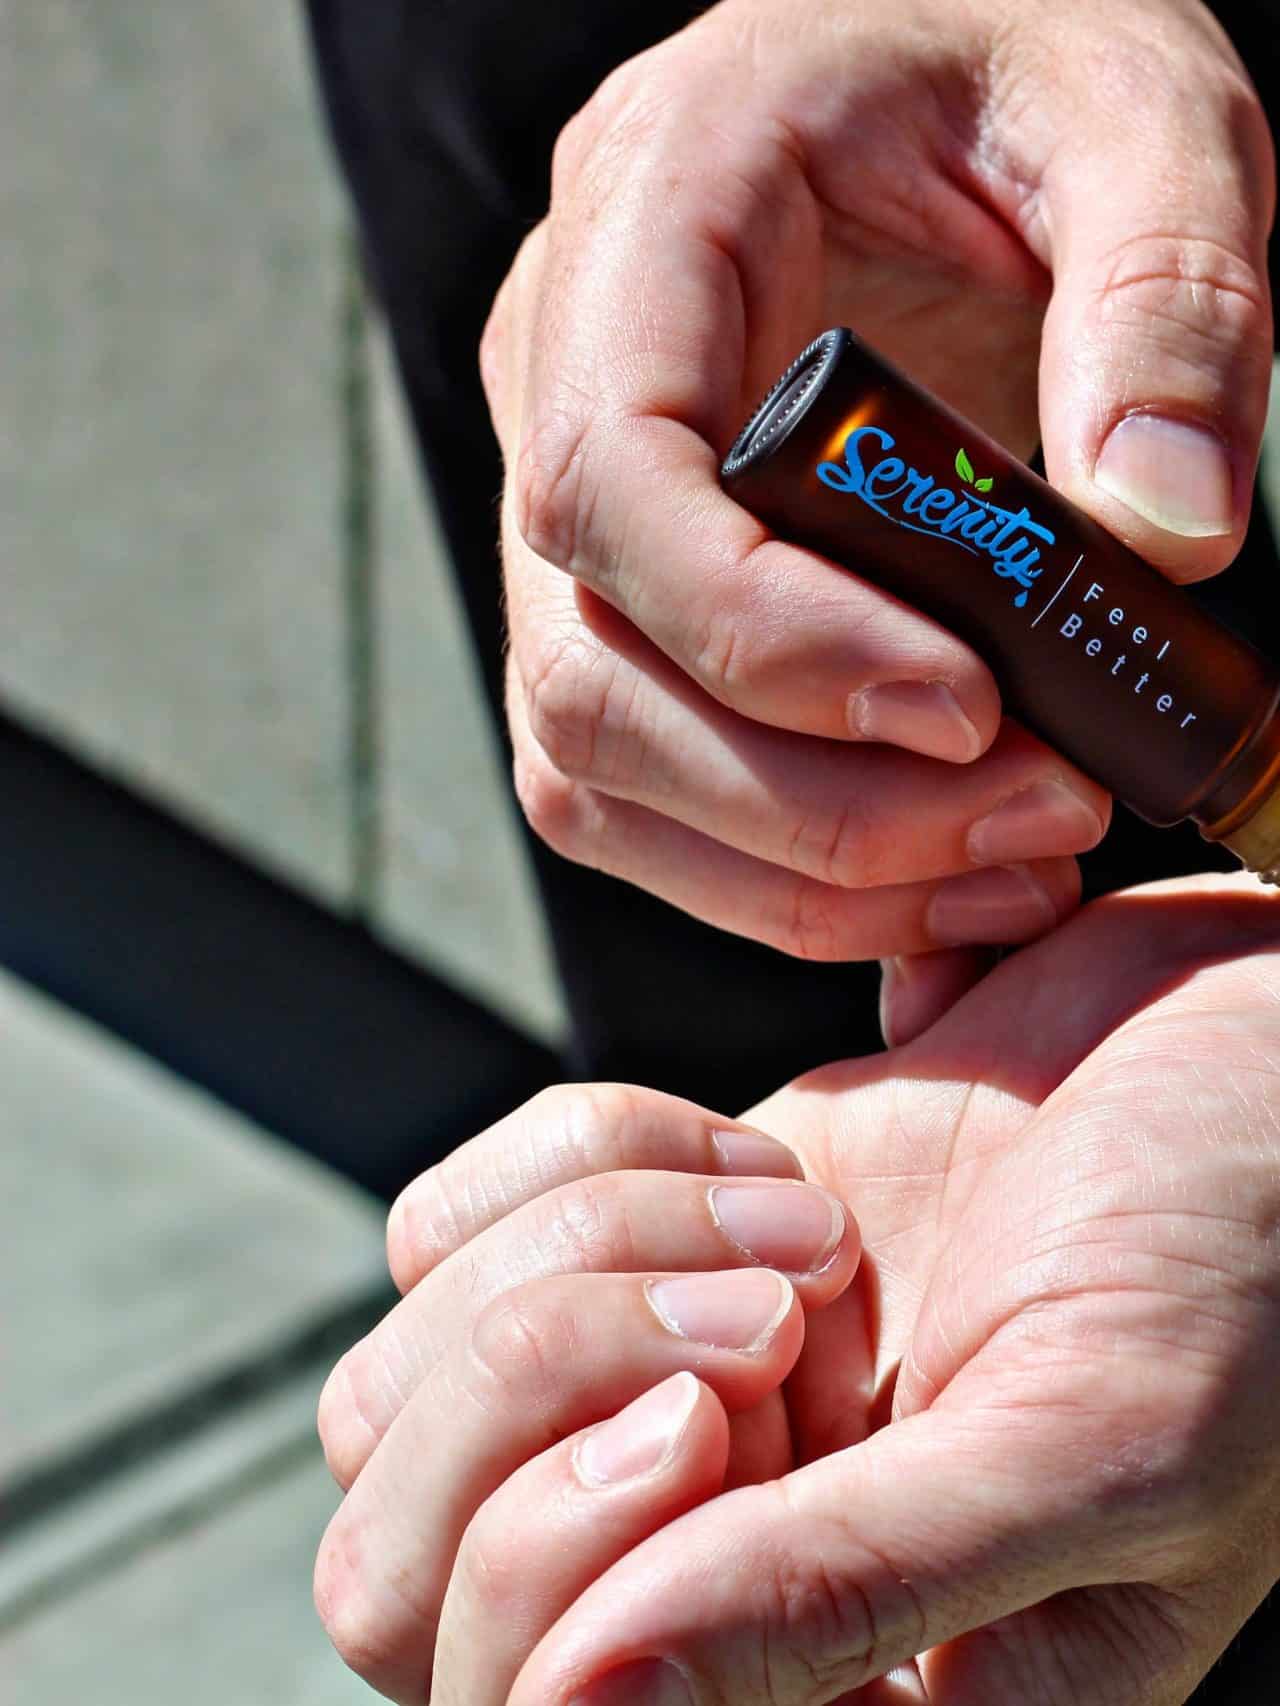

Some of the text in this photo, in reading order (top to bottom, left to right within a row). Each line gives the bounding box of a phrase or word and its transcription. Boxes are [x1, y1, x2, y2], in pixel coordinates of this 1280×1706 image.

[816, 426, 1056, 589] Serenity
[1060, 613, 1197, 729] Better
[1083, 582, 1171, 661] Feel
